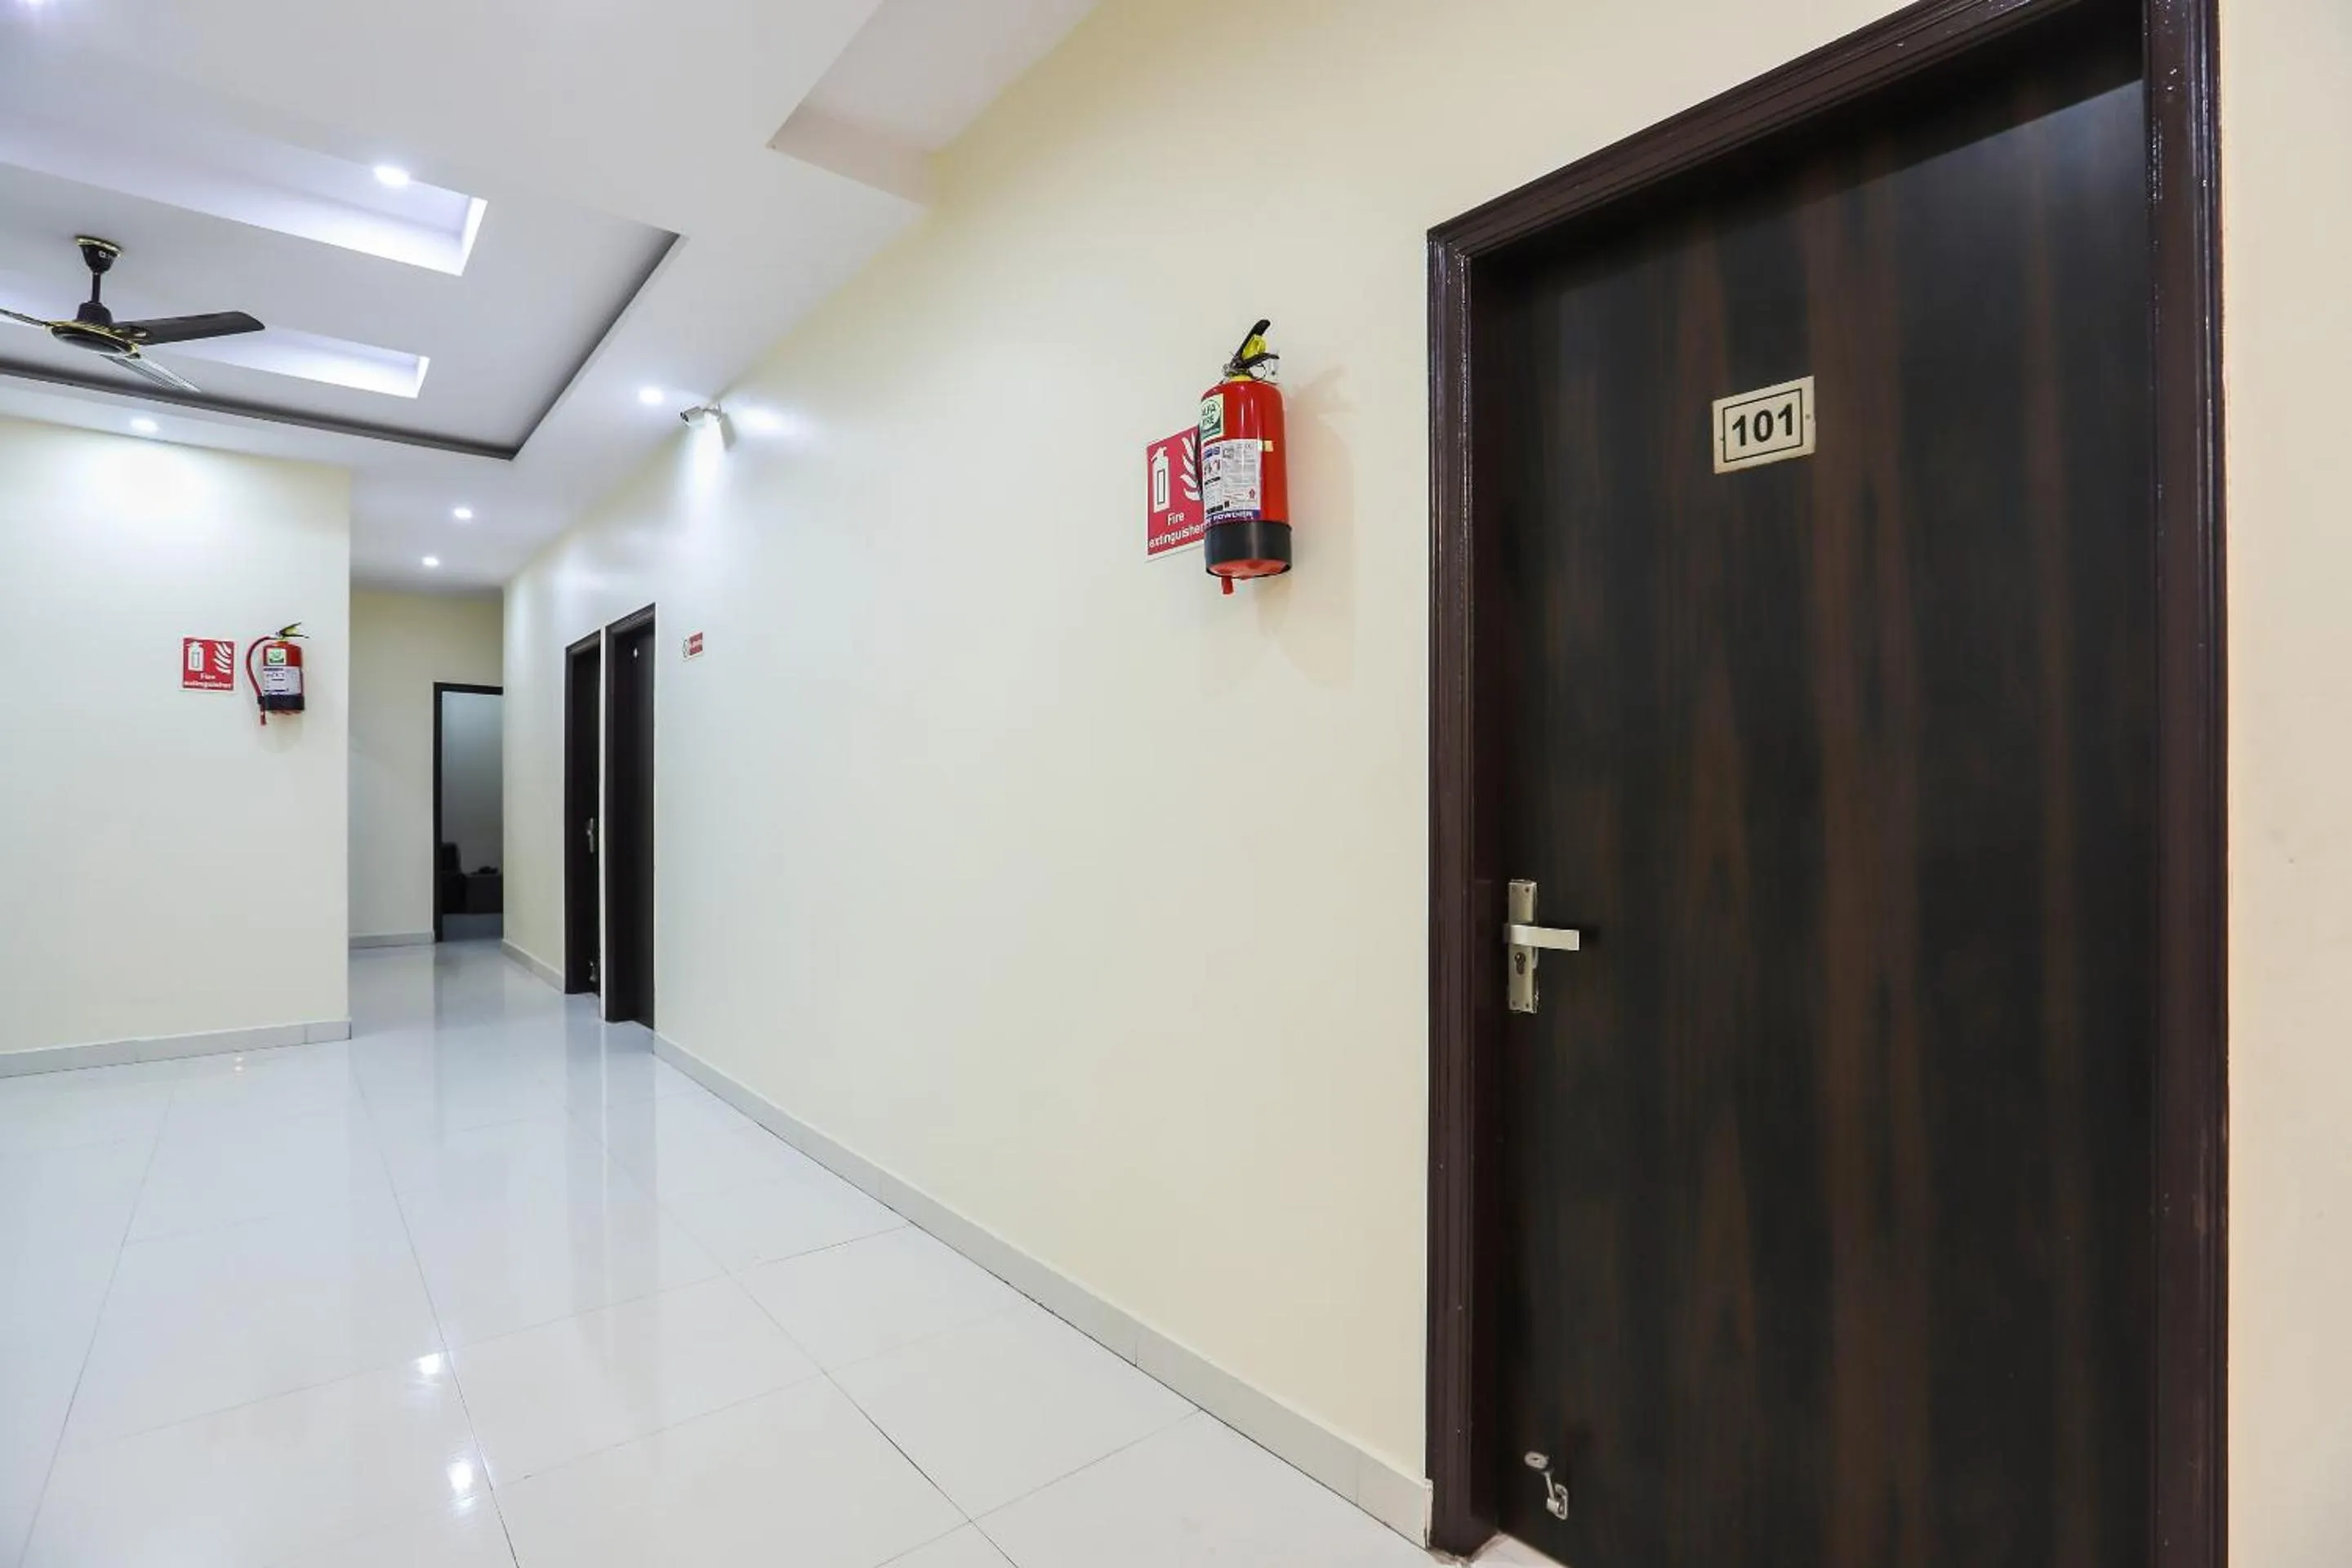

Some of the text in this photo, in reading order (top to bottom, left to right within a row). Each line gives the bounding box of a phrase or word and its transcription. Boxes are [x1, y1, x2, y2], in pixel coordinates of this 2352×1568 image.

[1732, 403, 1793, 447] 101
[1167, 512, 1185, 526] Fire
[1149, 523, 1205, 548] extinguisher
